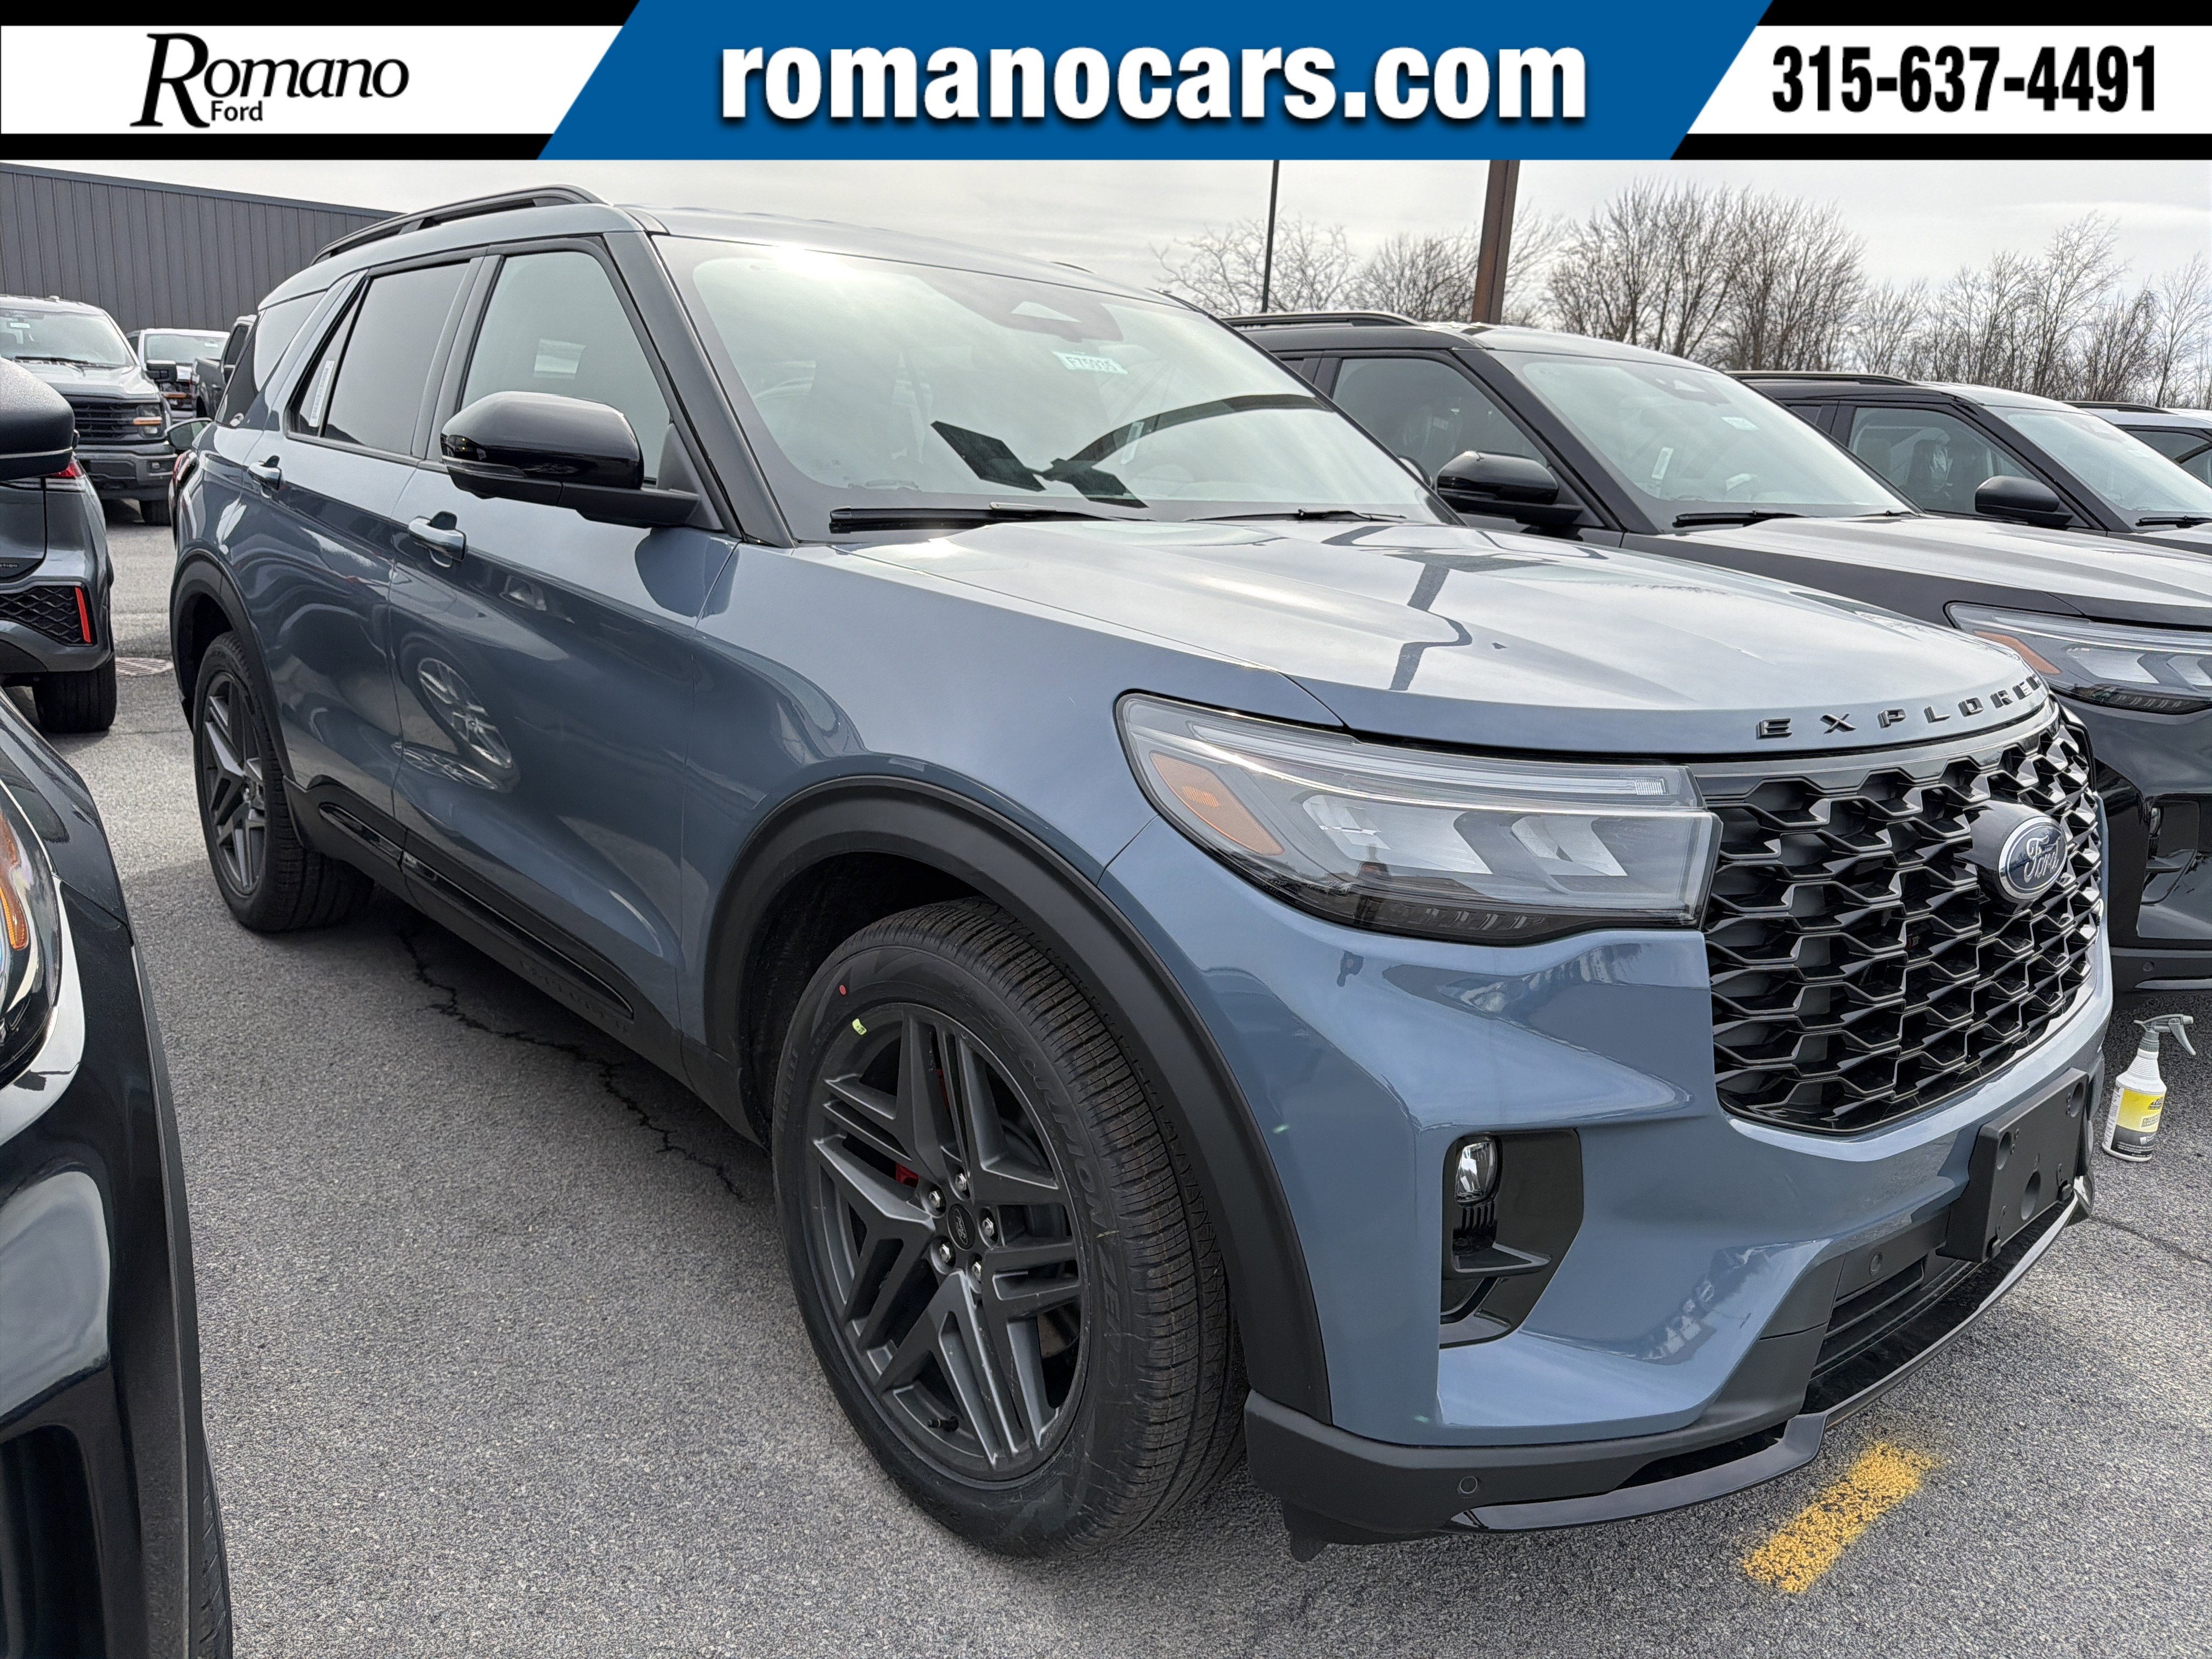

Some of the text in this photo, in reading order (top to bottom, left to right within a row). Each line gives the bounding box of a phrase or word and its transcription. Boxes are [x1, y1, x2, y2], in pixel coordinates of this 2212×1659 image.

[1756, 673, 2042, 738] EXPLORER
[2023, 835, 2062, 884] Ford
[980, 1007, 1108, 1229] SCORPION
